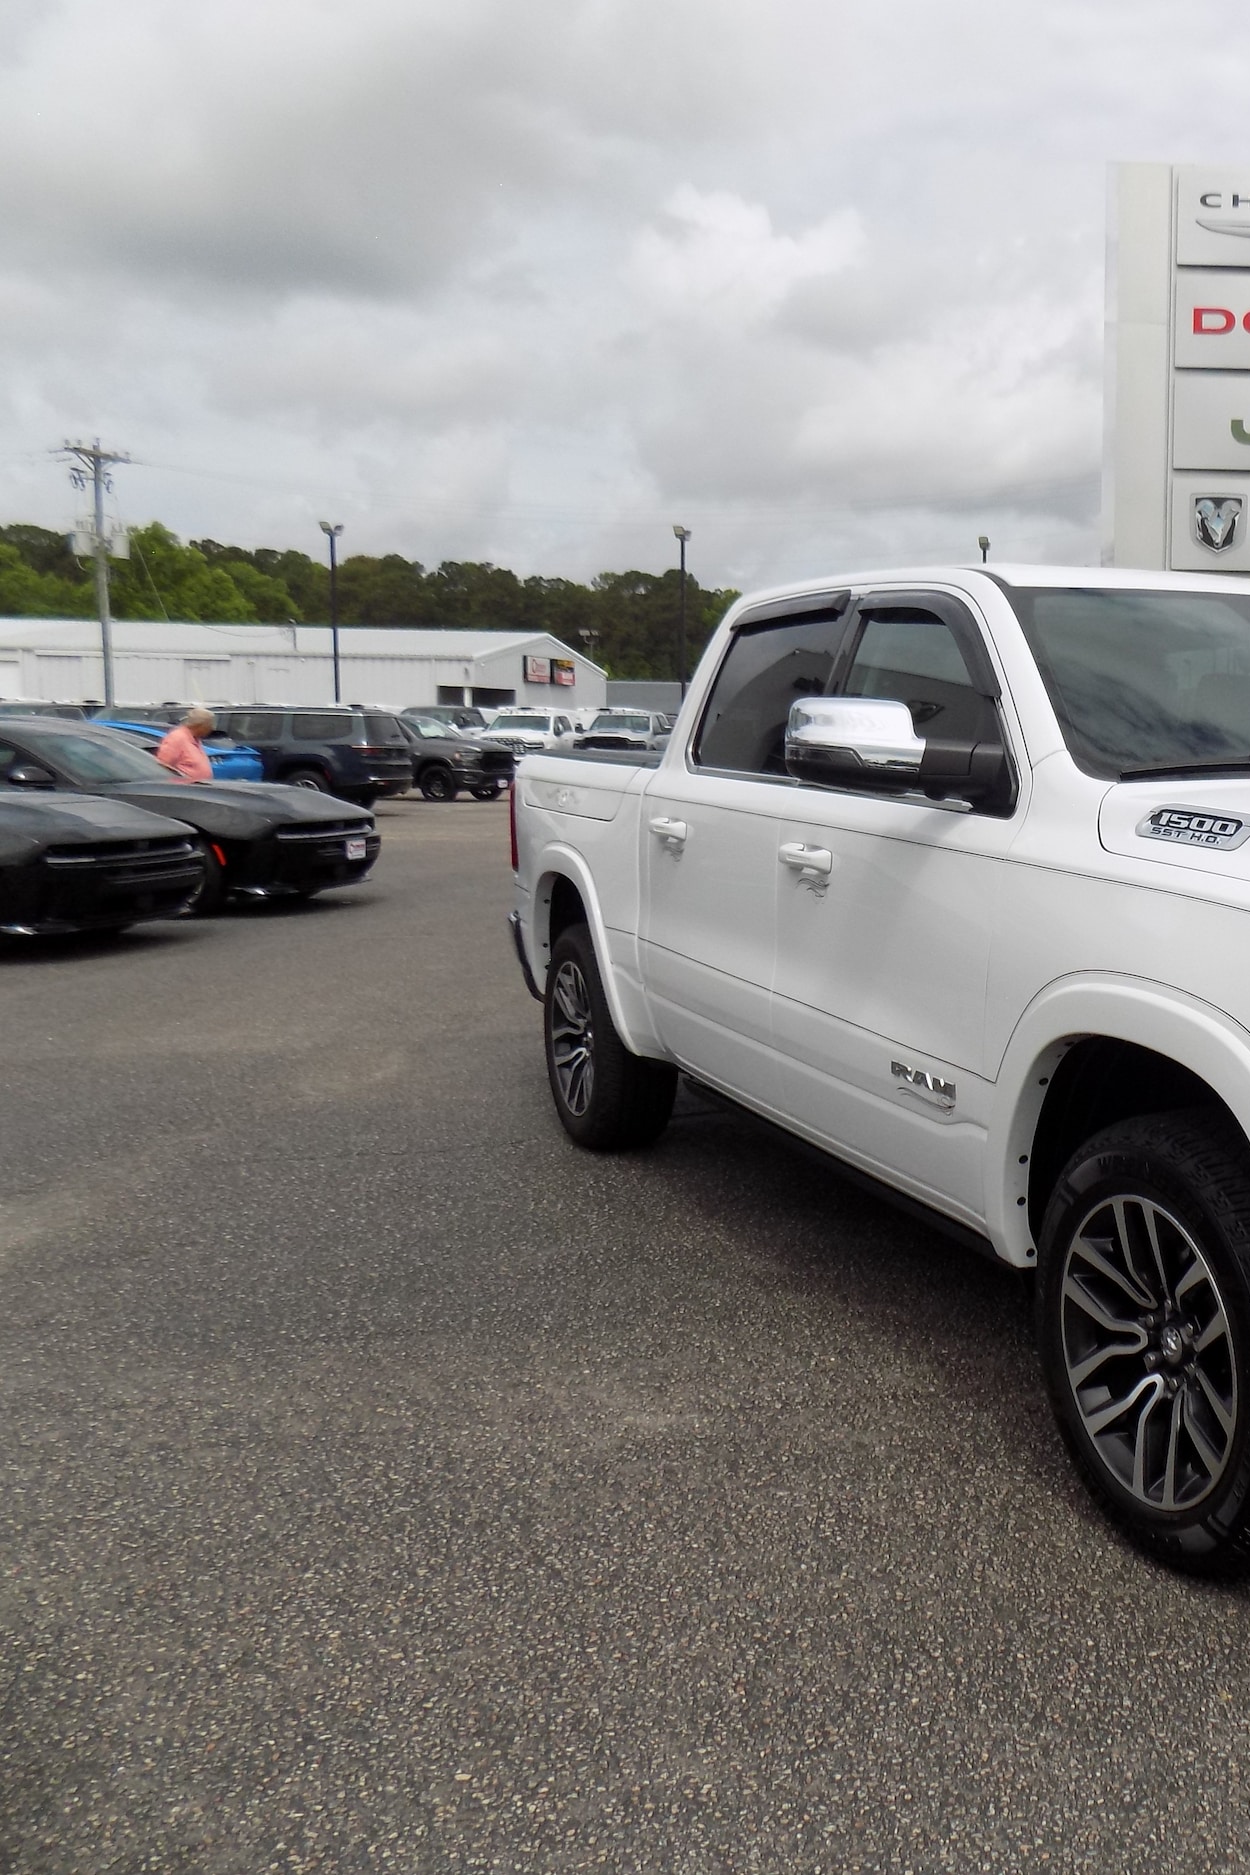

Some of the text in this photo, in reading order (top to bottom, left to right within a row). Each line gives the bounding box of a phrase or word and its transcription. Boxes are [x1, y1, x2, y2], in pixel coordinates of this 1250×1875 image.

[1150, 826, 1187, 838] SST
[1158, 812, 1238, 836] 1500
[890, 1060, 956, 1101] RAM
